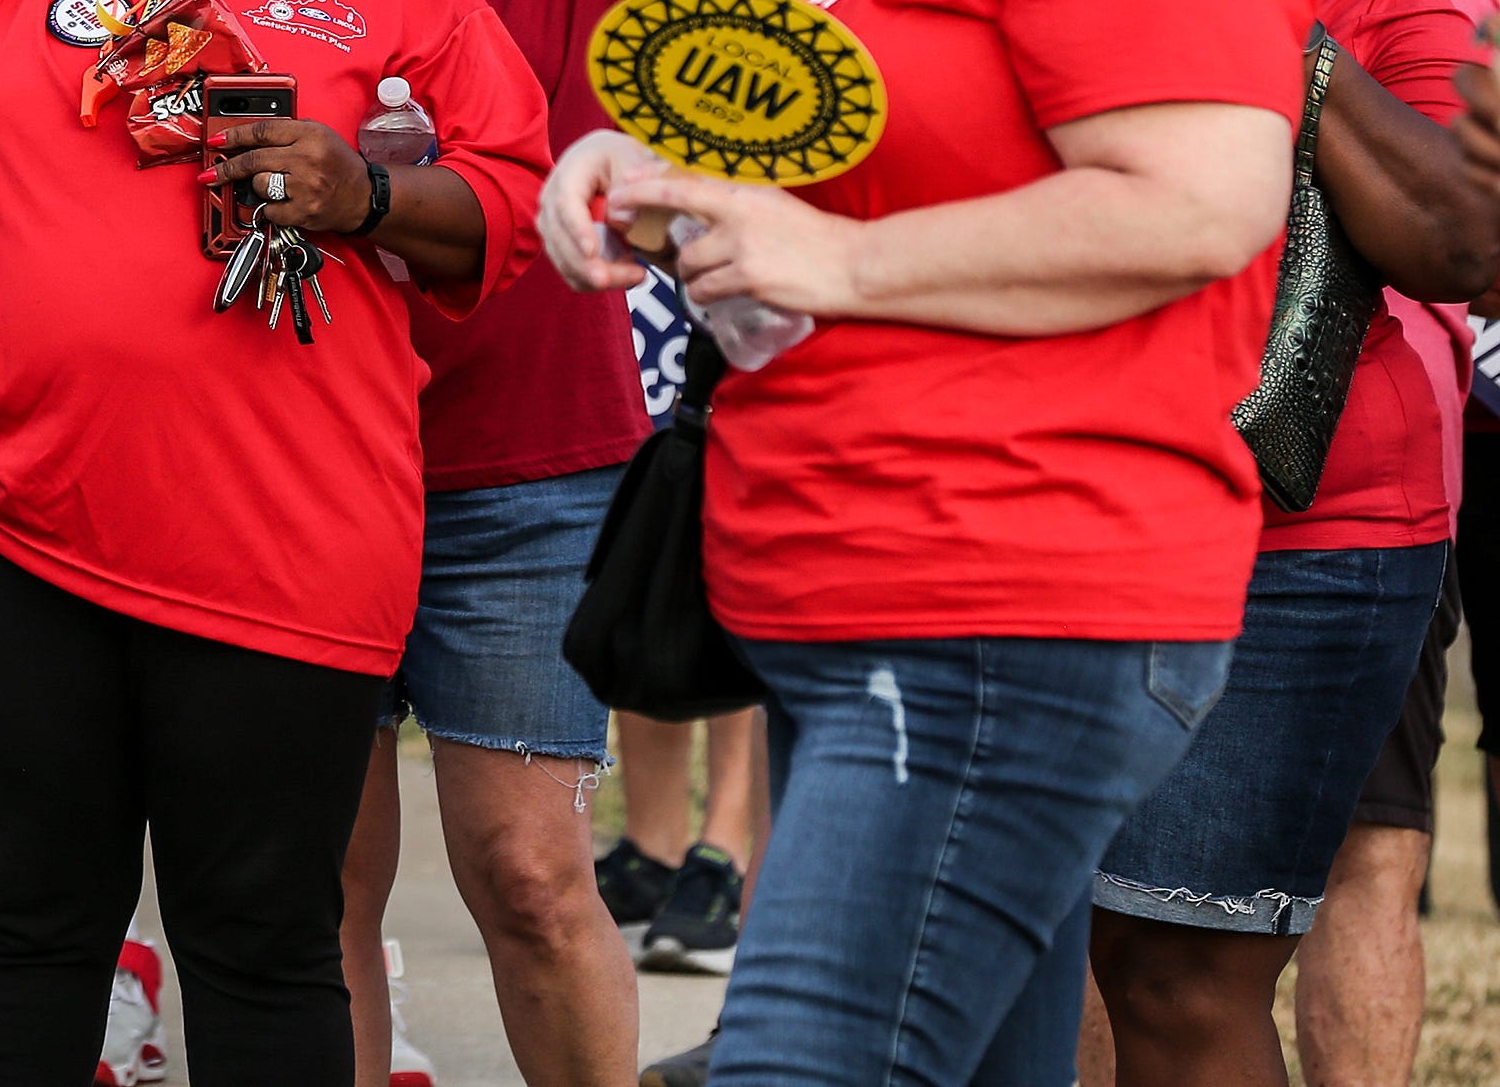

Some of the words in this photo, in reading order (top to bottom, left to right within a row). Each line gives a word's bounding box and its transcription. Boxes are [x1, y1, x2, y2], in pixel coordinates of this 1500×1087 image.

[252, 17, 300, 35] Kentucky
[298, 27, 328, 42] Truck
[328, 37, 352, 54] Plant
[332, 17, 363, 35] LINCOLN
[706, 34, 795, 82] LOCAL
[675, 46, 803, 121] UAW
